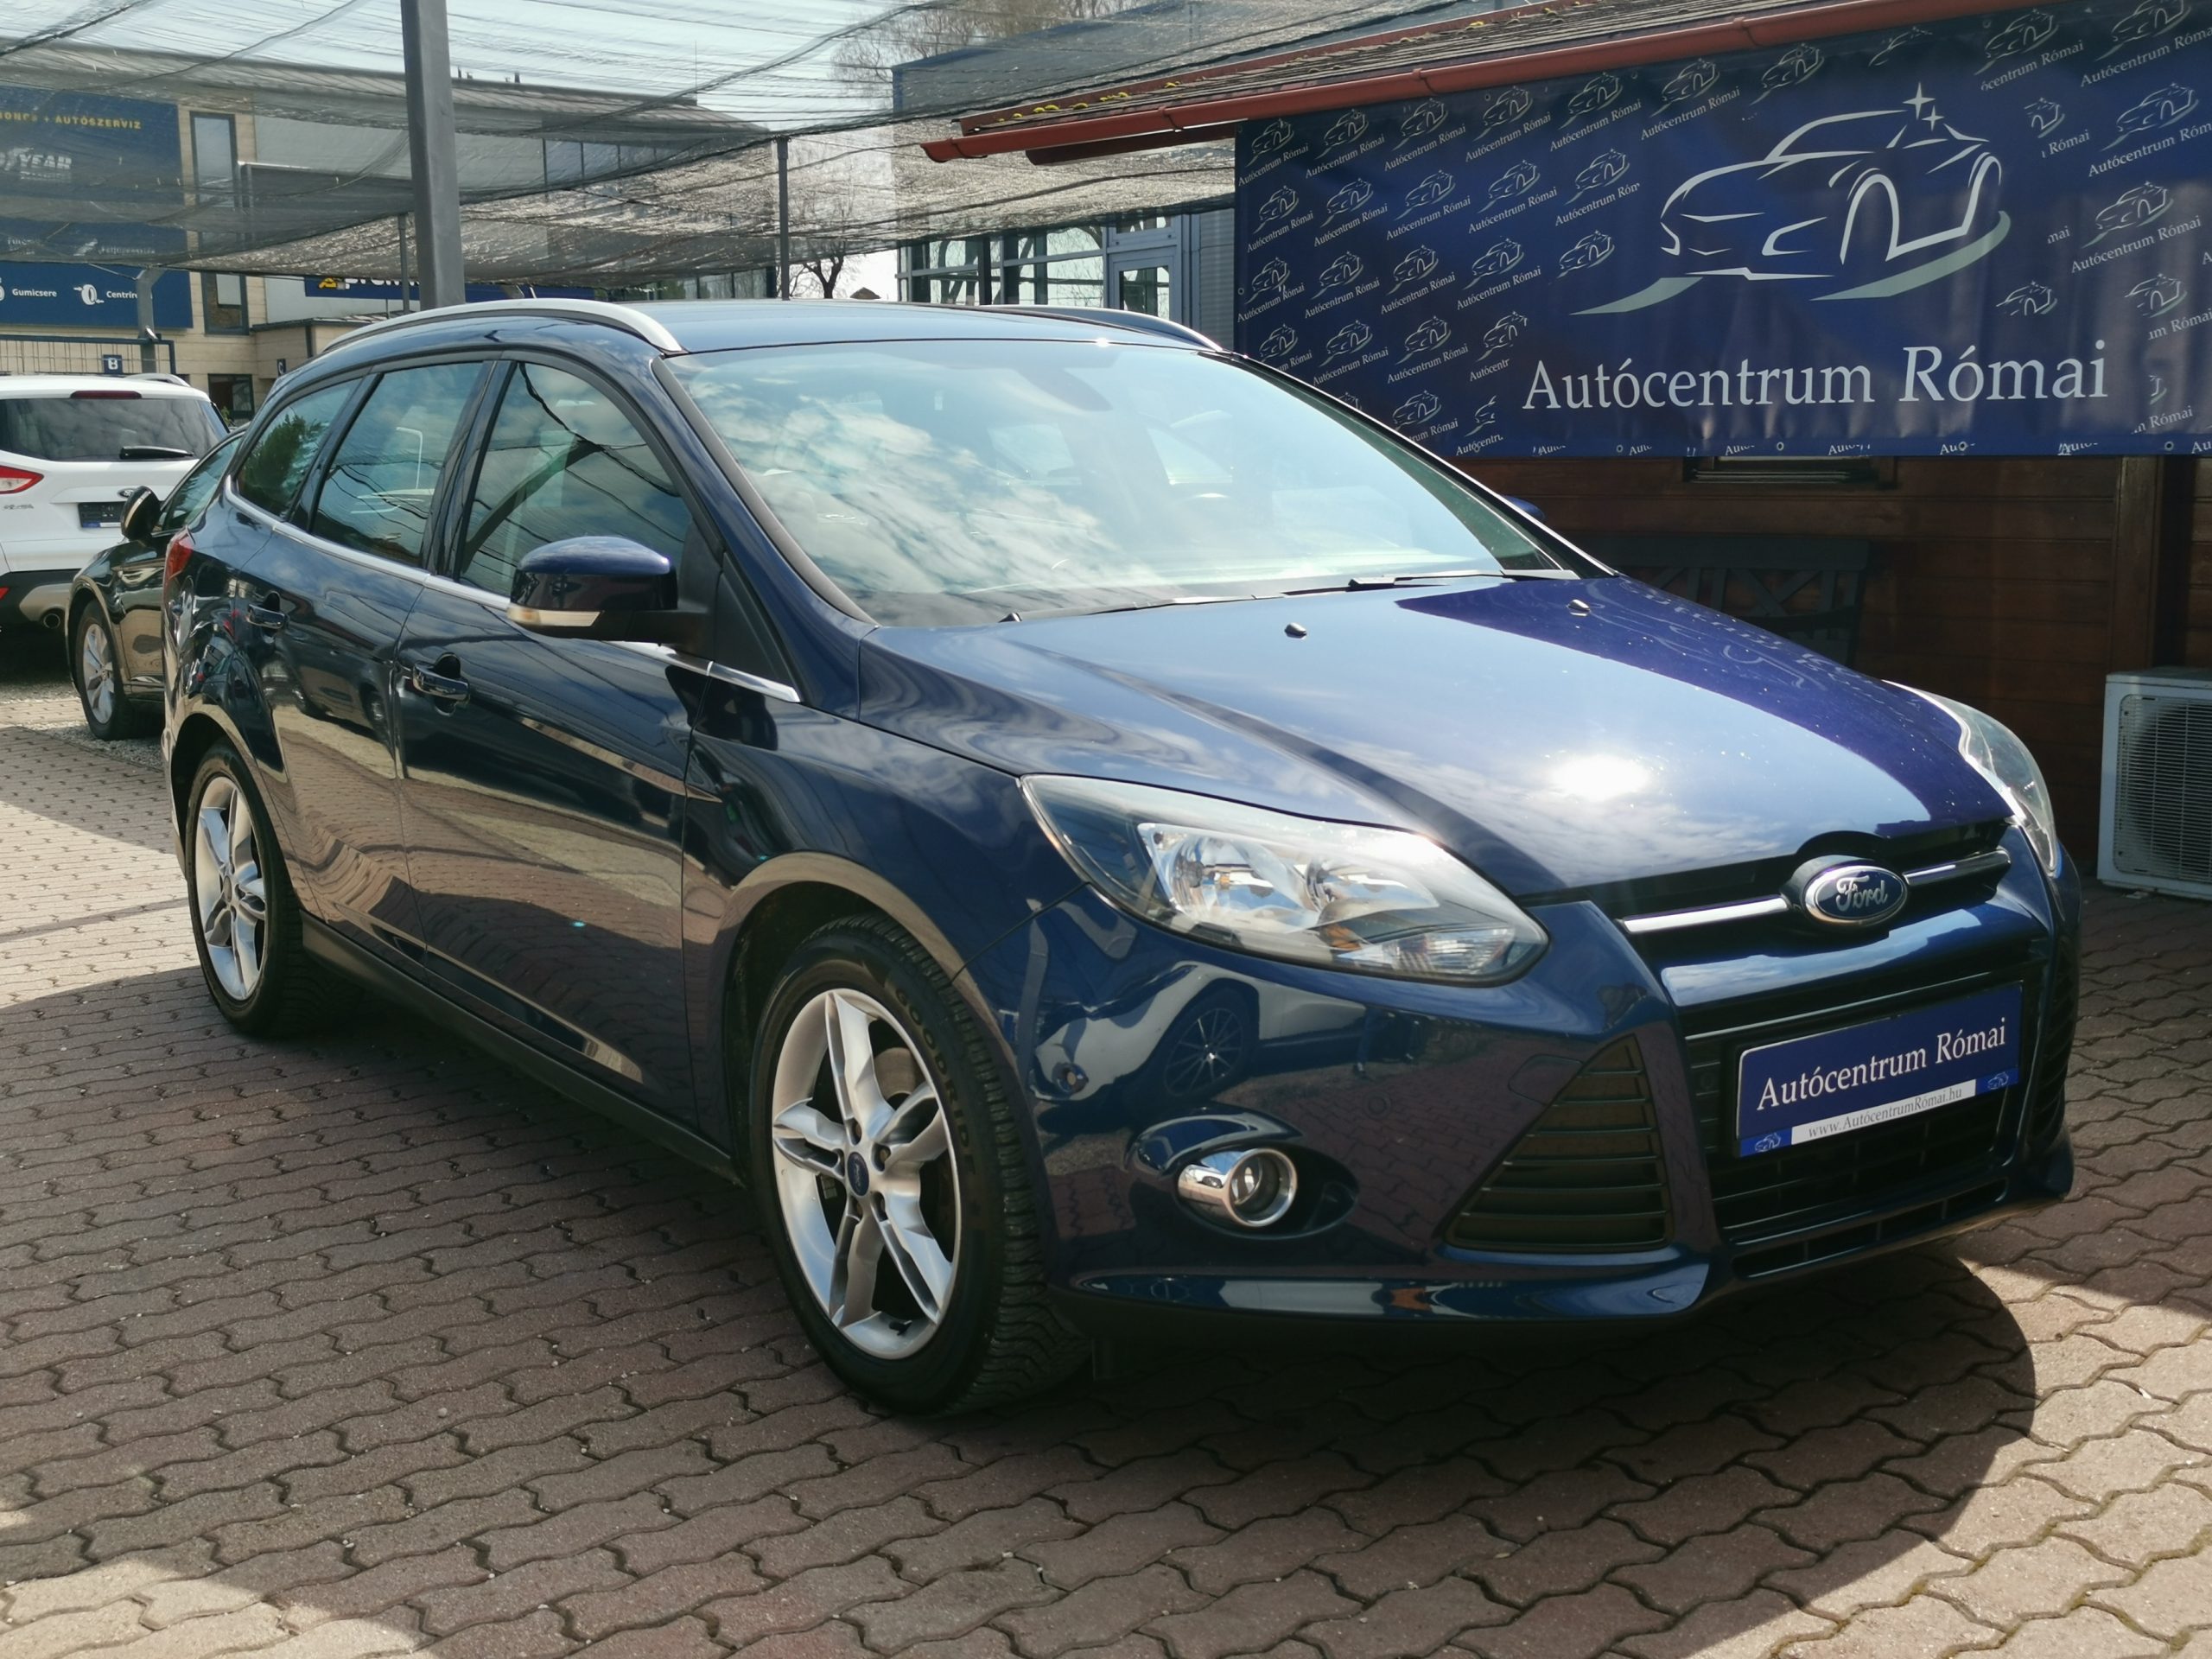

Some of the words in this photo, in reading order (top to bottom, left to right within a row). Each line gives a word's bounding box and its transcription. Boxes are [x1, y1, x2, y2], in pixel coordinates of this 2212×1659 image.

[2041, 40, 2084, 66] Római
[2081, 45, 2171, 87] Autócentrum
[55, 114, 141, 129] AUTÓSZERVIZ
[1550, 118, 1610, 152] Autócentrum
[1611, 99, 1642, 120] Római
[1641, 105, 1707, 140] Autócentrum
[1708, 86, 1740, 110] Római
[1306, 149, 1358, 179] Autócentrum
[1359, 134, 1385, 153] Római
[1384, 142, 1438, 171] Autócentrum
[1439, 124, 1466, 144] Római
[1465, 130, 1522, 162] Autócentrum
[1523, 111, 1551, 132] Római
[2049, 130, 2090, 156] Római
[2088, 135, 2176, 177] Autócentrum
[1238, 156, 1287, 186] Autócentrum
[1283, 143, 1309, 162] Római
[1314, 218, 1360, 247] Autócentrum
[1362, 203, 1388, 224] Római
[1386, 211, 1440, 240] Autócentrum
[1443, 195, 1471, 216] Római
[1469, 201, 1526, 233] Autócentrum
[1528, 187, 1558, 207] Római
[1555, 194, 1616, 226] Autócentrum
[1247, 224, 1289, 253] Autócentrum
[1290, 212, 1314, 230] Római
[2071, 234, 2155, 273] Autócentrum
[2158, 214, 2202, 240] Római
[12, 289, 57, 298] Gumicsere
[1236, 296, 1281, 323] Autócentrum
[1282, 283, 1306, 301] Római
[1305, 291, 1354, 319] Autócentrum
[1356, 277, 1380, 296] Római
[1381, 288, 1429, 315] Autócentrum
[1430, 271, 1455, 292] Római
[1457, 281, 1510, 310] Autócentrum
[1513, 265, 1541, 287] Római
[107, 358, 118, 370] B
[1290, 350, 1313, 368] Római
[1313, 359, 1361, 386] Autócentrum
[1362, 347, 1389, 366] Római
[1388, 357, 1441, 384] Autócentrum
[1442, 343, 1469, 365] Római
[1522, 358, 1875, 410] Autócentrum
[1898, 340, 2108, 403] Római
[1430, 418, 1459, 437] Római
[2150, 405, 2194, 428] Római
[1836, 875, 1888, 912] Ford
[1757, 1048, 1926, 1111] Autócentrum
[1936, 1017, 2005, 1064] Római
[1808, 1087, 1962, 1138] www.AutócentrumRómai.hu
